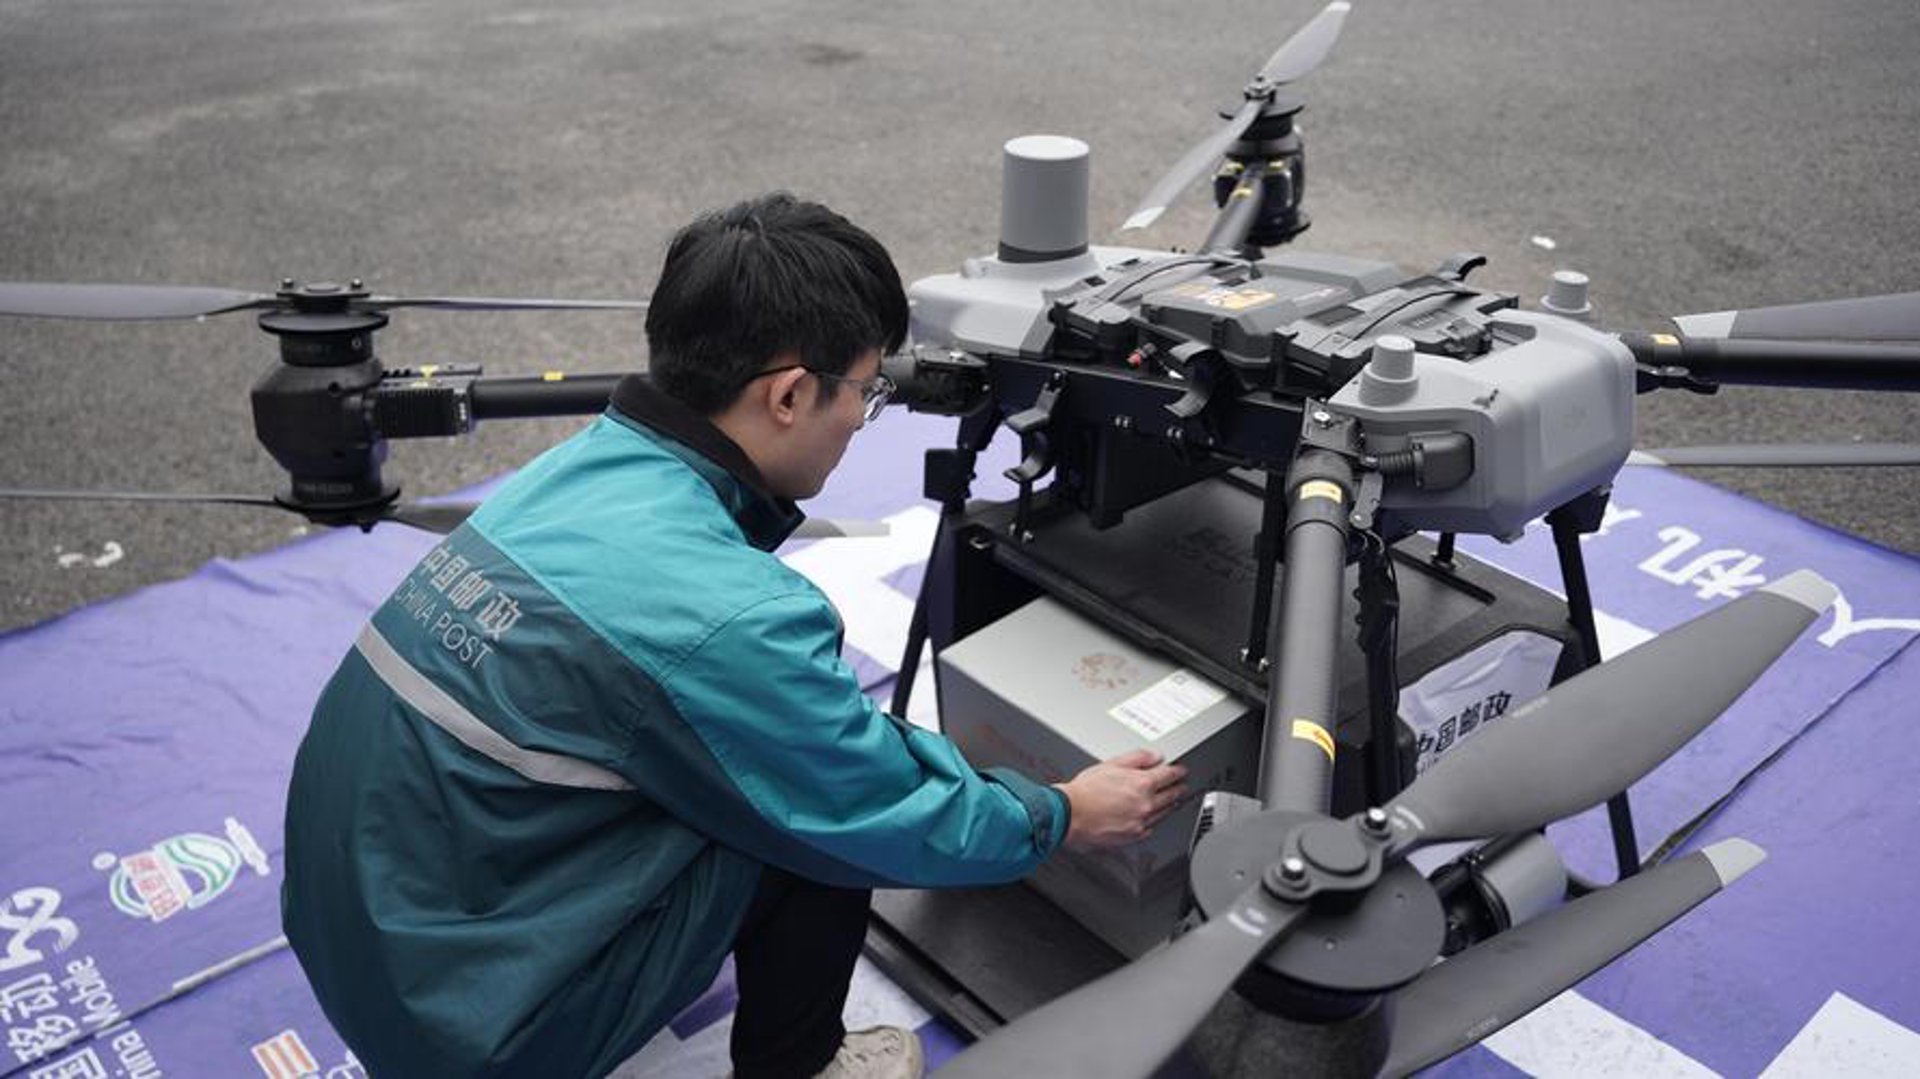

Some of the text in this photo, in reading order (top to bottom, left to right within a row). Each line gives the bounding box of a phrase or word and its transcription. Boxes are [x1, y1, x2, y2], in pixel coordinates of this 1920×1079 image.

[421, 545, 523, 642] 中国邮政
[430, 611, 494, 669] POST
[1416, 690, 1512, 753] 中国邮政
[60, 955, 131, 1039] Mobile
